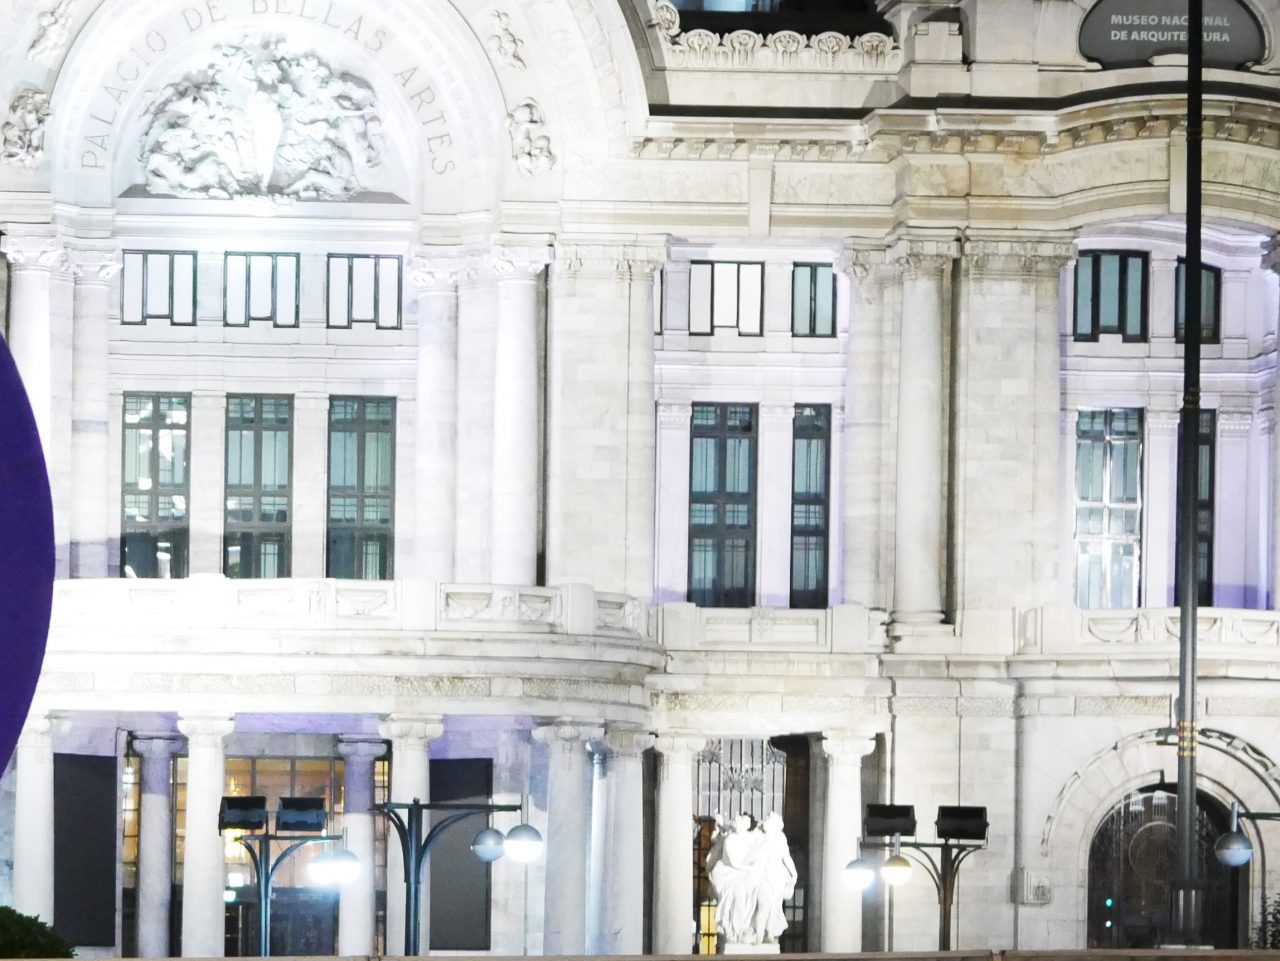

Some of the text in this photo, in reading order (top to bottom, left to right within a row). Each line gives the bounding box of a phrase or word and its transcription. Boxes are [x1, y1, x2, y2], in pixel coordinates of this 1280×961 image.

[1111, 14, 1231, 26] MUSEO NACNAL
[1111, 30, 1231, 42] DE ARQUITEURA
[81, 30, 168, 172] PALACIO
[181, 0, 228, 33] DE
[395, 66, 457, 177] ARTES
